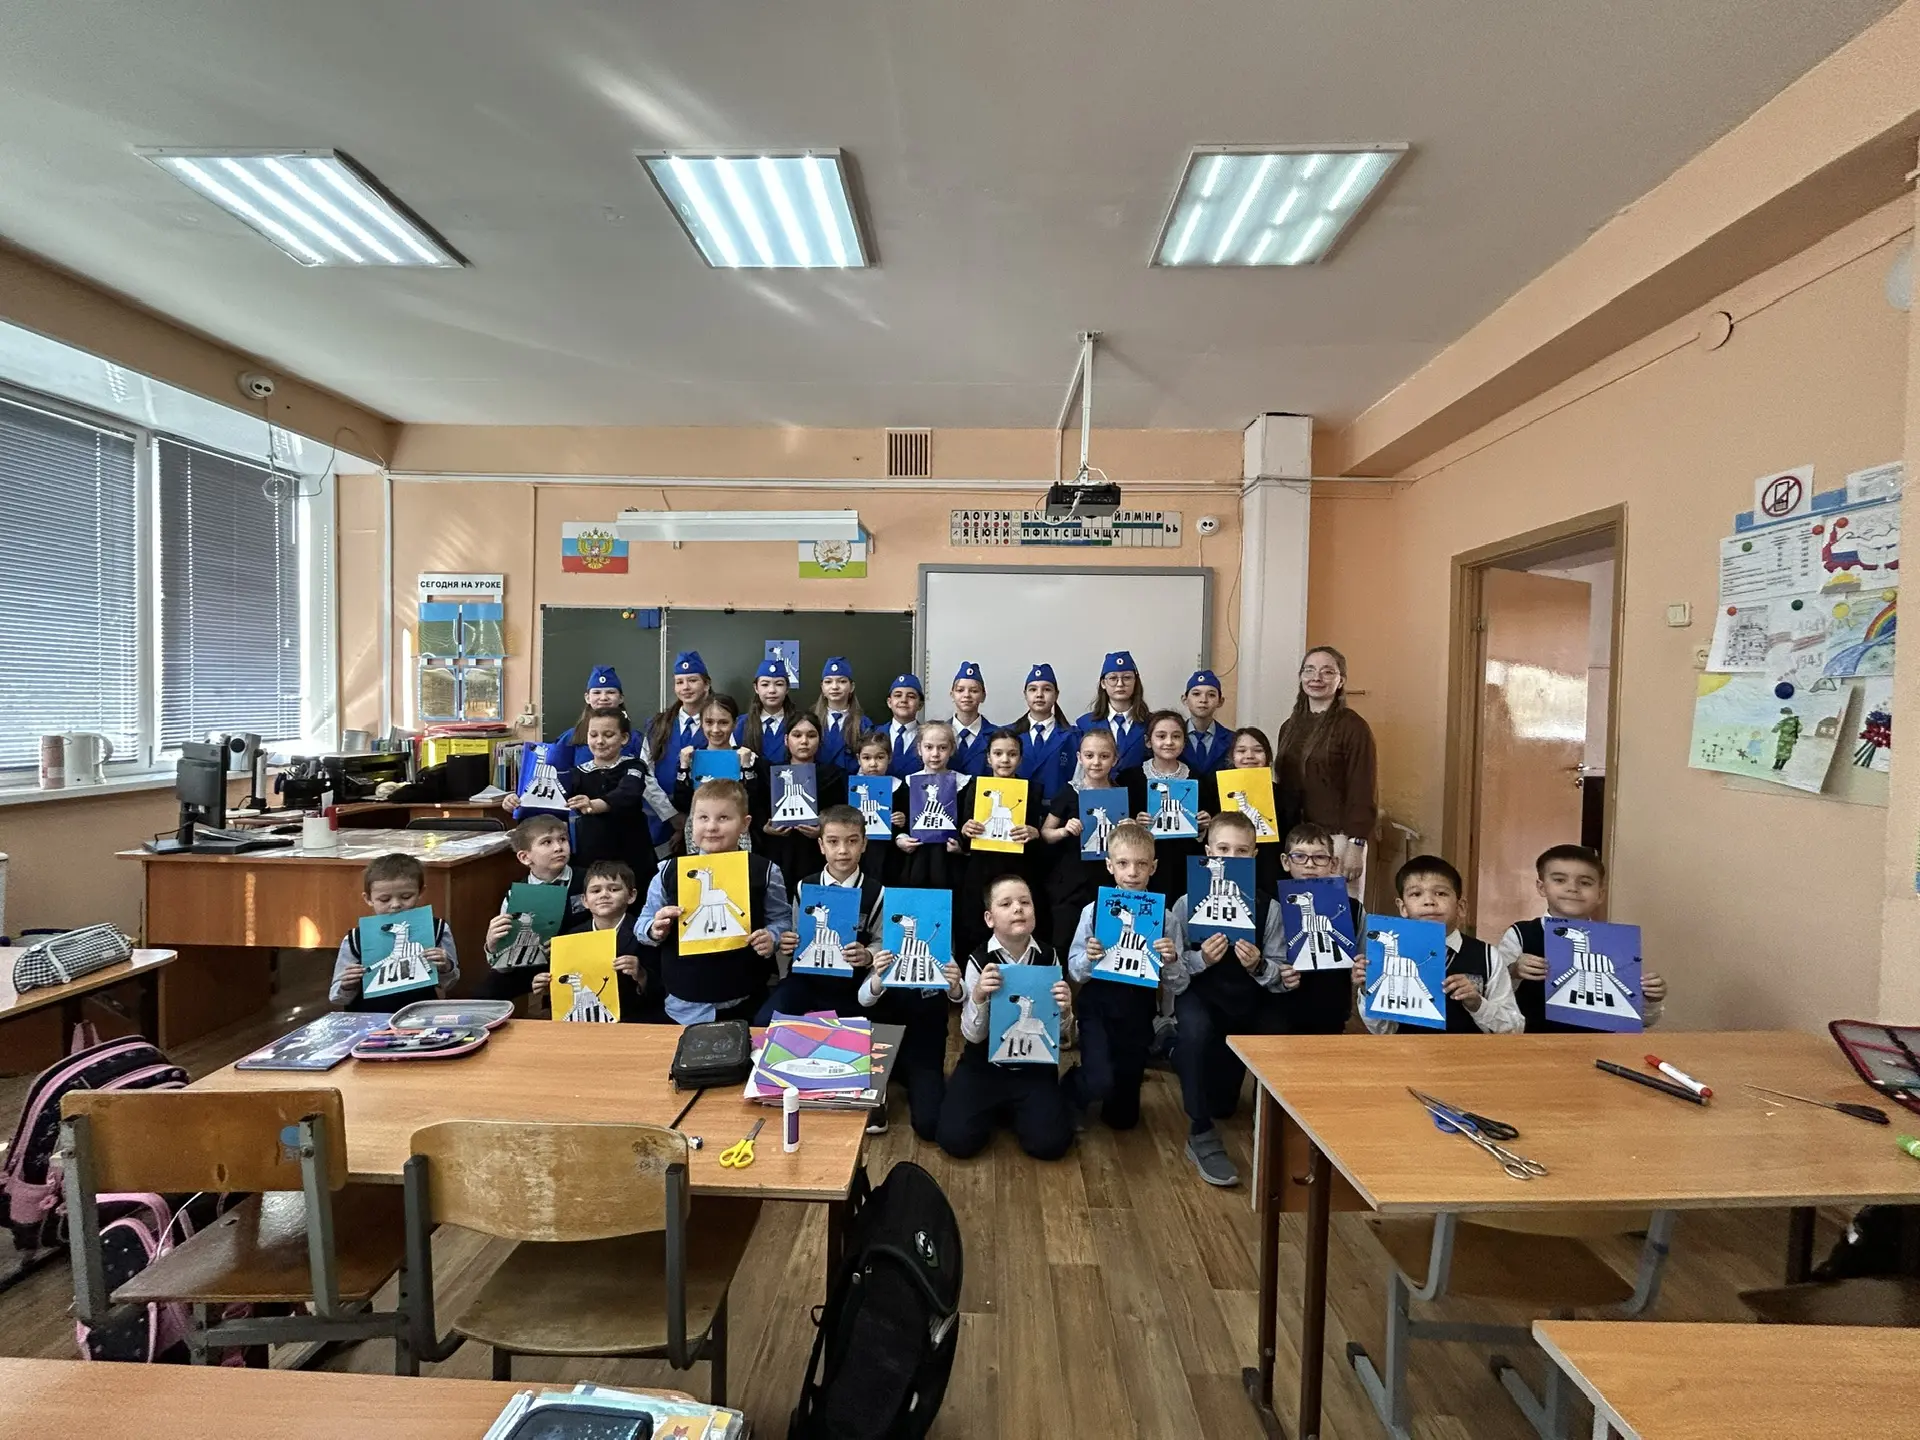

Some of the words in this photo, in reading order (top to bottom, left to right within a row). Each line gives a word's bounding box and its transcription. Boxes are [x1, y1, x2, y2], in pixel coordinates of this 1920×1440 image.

[963, 511, 970, 521] А
[973, 511, 980, 521] О
[983, 511, 990, 521] У
[1002, 511, 1010, 521] Ы
[1023, 511, 1030, 521] Б
[1124, 511, 1131, 521] Л
[1133, 511, 1142, 521] М
[1145, 511, 1152, 521] Н
[1156, 511, 1162, 521] Р
[963, 528, 969, 537] Я
[974, 527, 979, 539] Ё
[982, 528, 991, 537] Ю
[993, 528, 999, 537] Е
[1003, 528, 1010, 537] И
[1023, 528, 1030, 537] П
[1032, 528, 1041, 537] Ф
[1043, 528, 1050, 537] К
[1053, 528, 1060, 537] Т
[1063, 528, 1069, 538] С
[1072, 528, 1081, 537] Ш
[1083, 528, 1090, 539] Ц
[1093, 529, 1100, 538] Ч
[1102, 529, 1112, 539] Щ
[1113, 529, 1121, 538] Х
[420, 580, 459, 589] СЕГОДНЯ
[461, 580, 473, 588] НА
